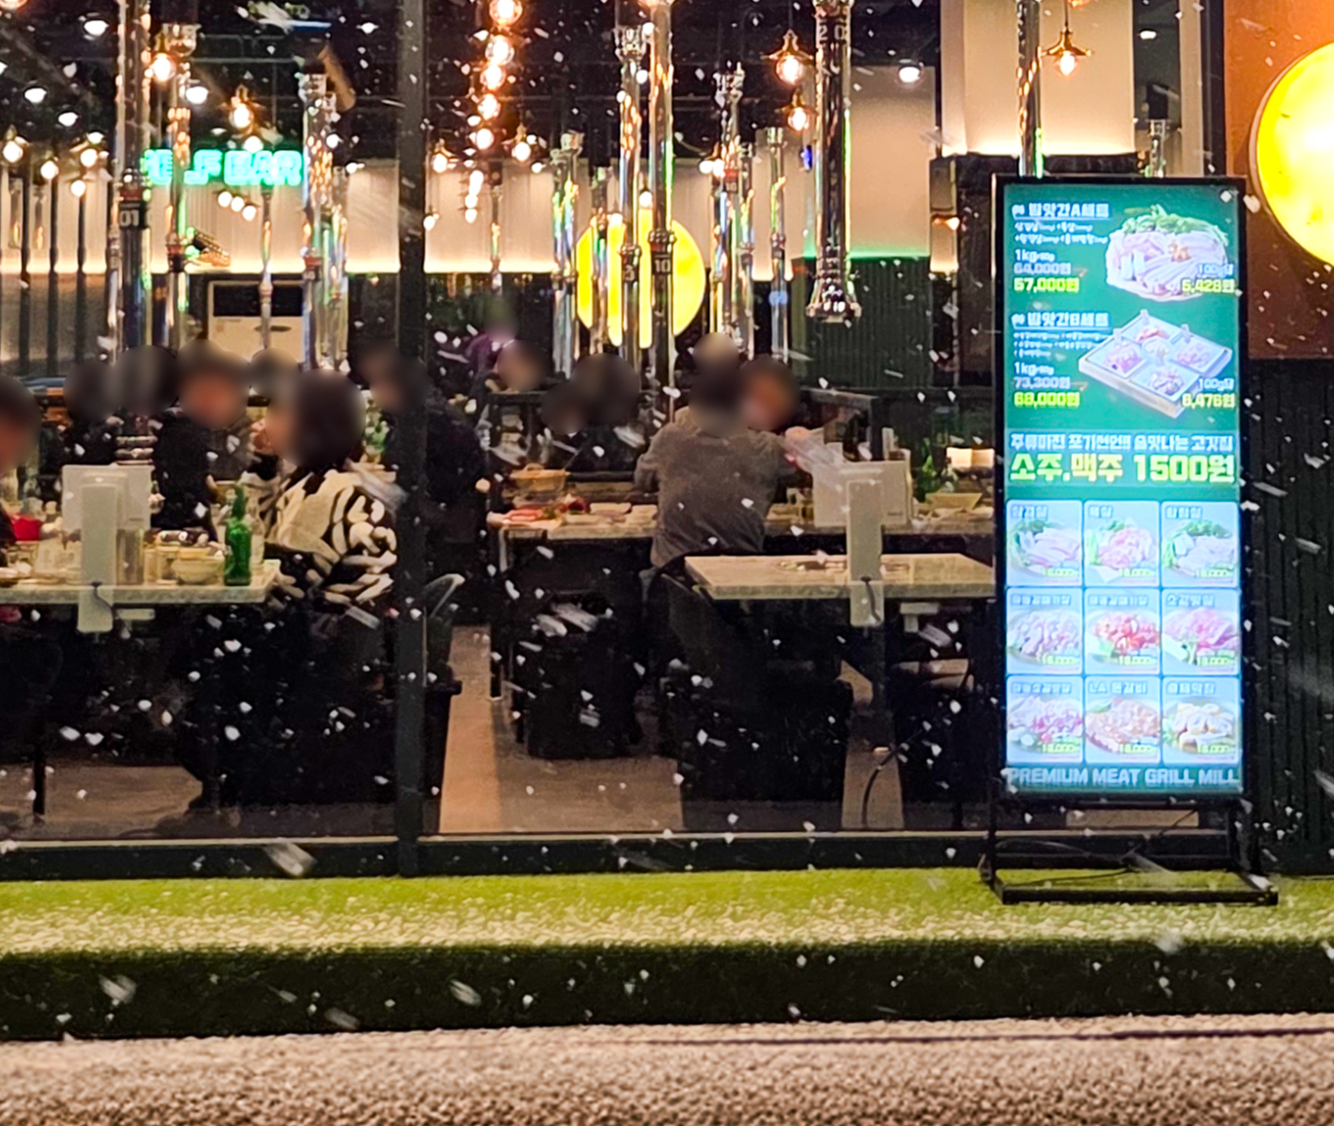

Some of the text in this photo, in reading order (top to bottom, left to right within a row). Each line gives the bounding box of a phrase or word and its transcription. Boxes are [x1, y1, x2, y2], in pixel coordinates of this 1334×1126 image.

[120, 209, 140, 226] 01
[654, 258, 671, 273] 10
[1010, 433, 1066, 451] 주류마진
[1191, 435, 1234, 452] 고깃집
[1133, 454, 1235, 484] 1500원
[1006, 767, 1240, 788] PREMIUM MEAT GRILL MILL
